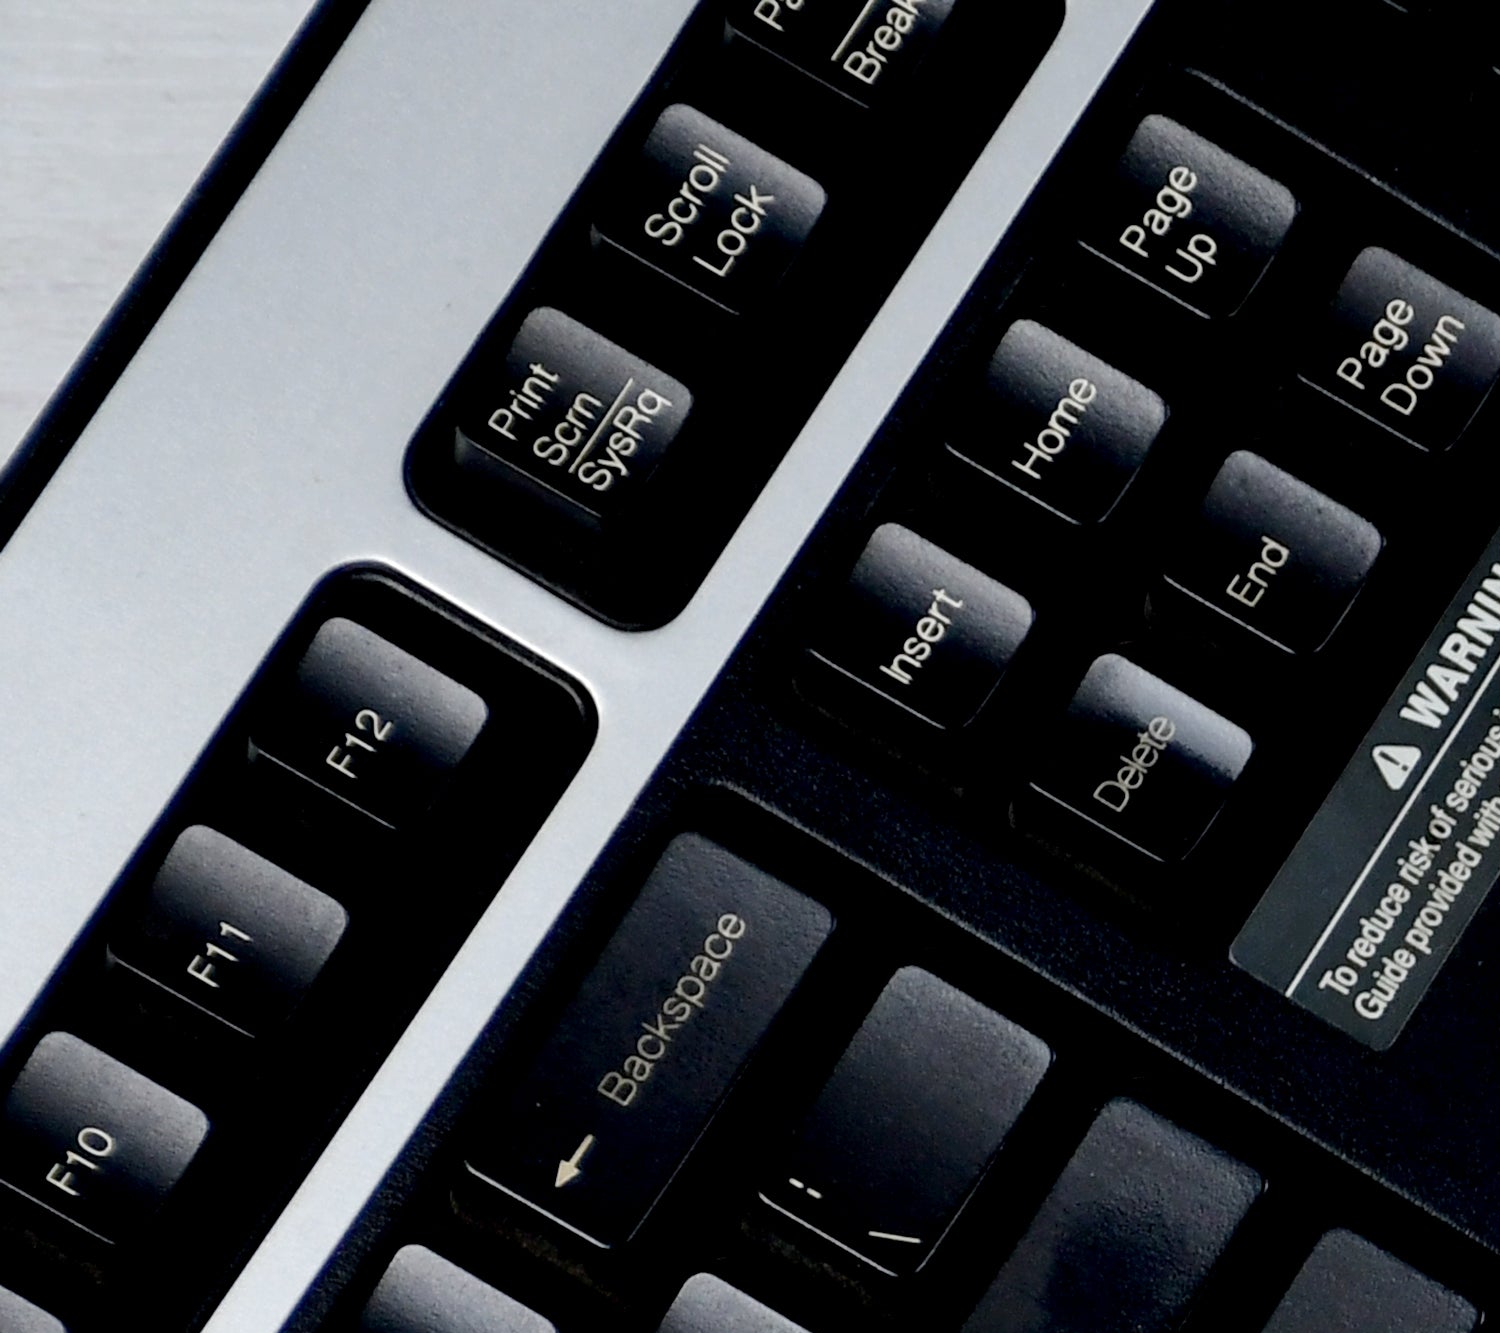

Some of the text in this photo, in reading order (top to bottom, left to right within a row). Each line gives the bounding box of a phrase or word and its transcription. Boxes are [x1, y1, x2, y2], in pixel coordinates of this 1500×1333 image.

[644, 144, 731, 247] Scroll
[693, 184, 777, 279] Lock
[1119, 164, 1198, 258] Page
[1165, 231, 1219, 285] Up
[1336, 297, 1415, 390] Page
[1380, 312, 1466, 417] Down
[487, 360, 562, 443] Print
[532, 391, 605, 467] Scrn
[577, 387, 673, 493] SysRq
[1011, 375, 1098, 481] Home
[1226, 536, 1291, 610] End
[880, 586, 964, 686] Insert
[325, 706, 395, 780] F12
[1093, 714, 1178, 814] Delete
[1318, 965, 1359, 996] To
[1346, 883, 1411, 968] reduce
[1397, 836, 1442, 886] risk
[1429, 804, 1457, 839] of
[1354, 948, 1417, 1020] Guide
[1404, 841, 1483, 955] provided
[186, 919, 253, 989] F11
[596, 909, 748, 1107] Backspace
[44, 1124, 114, 1197] F10
